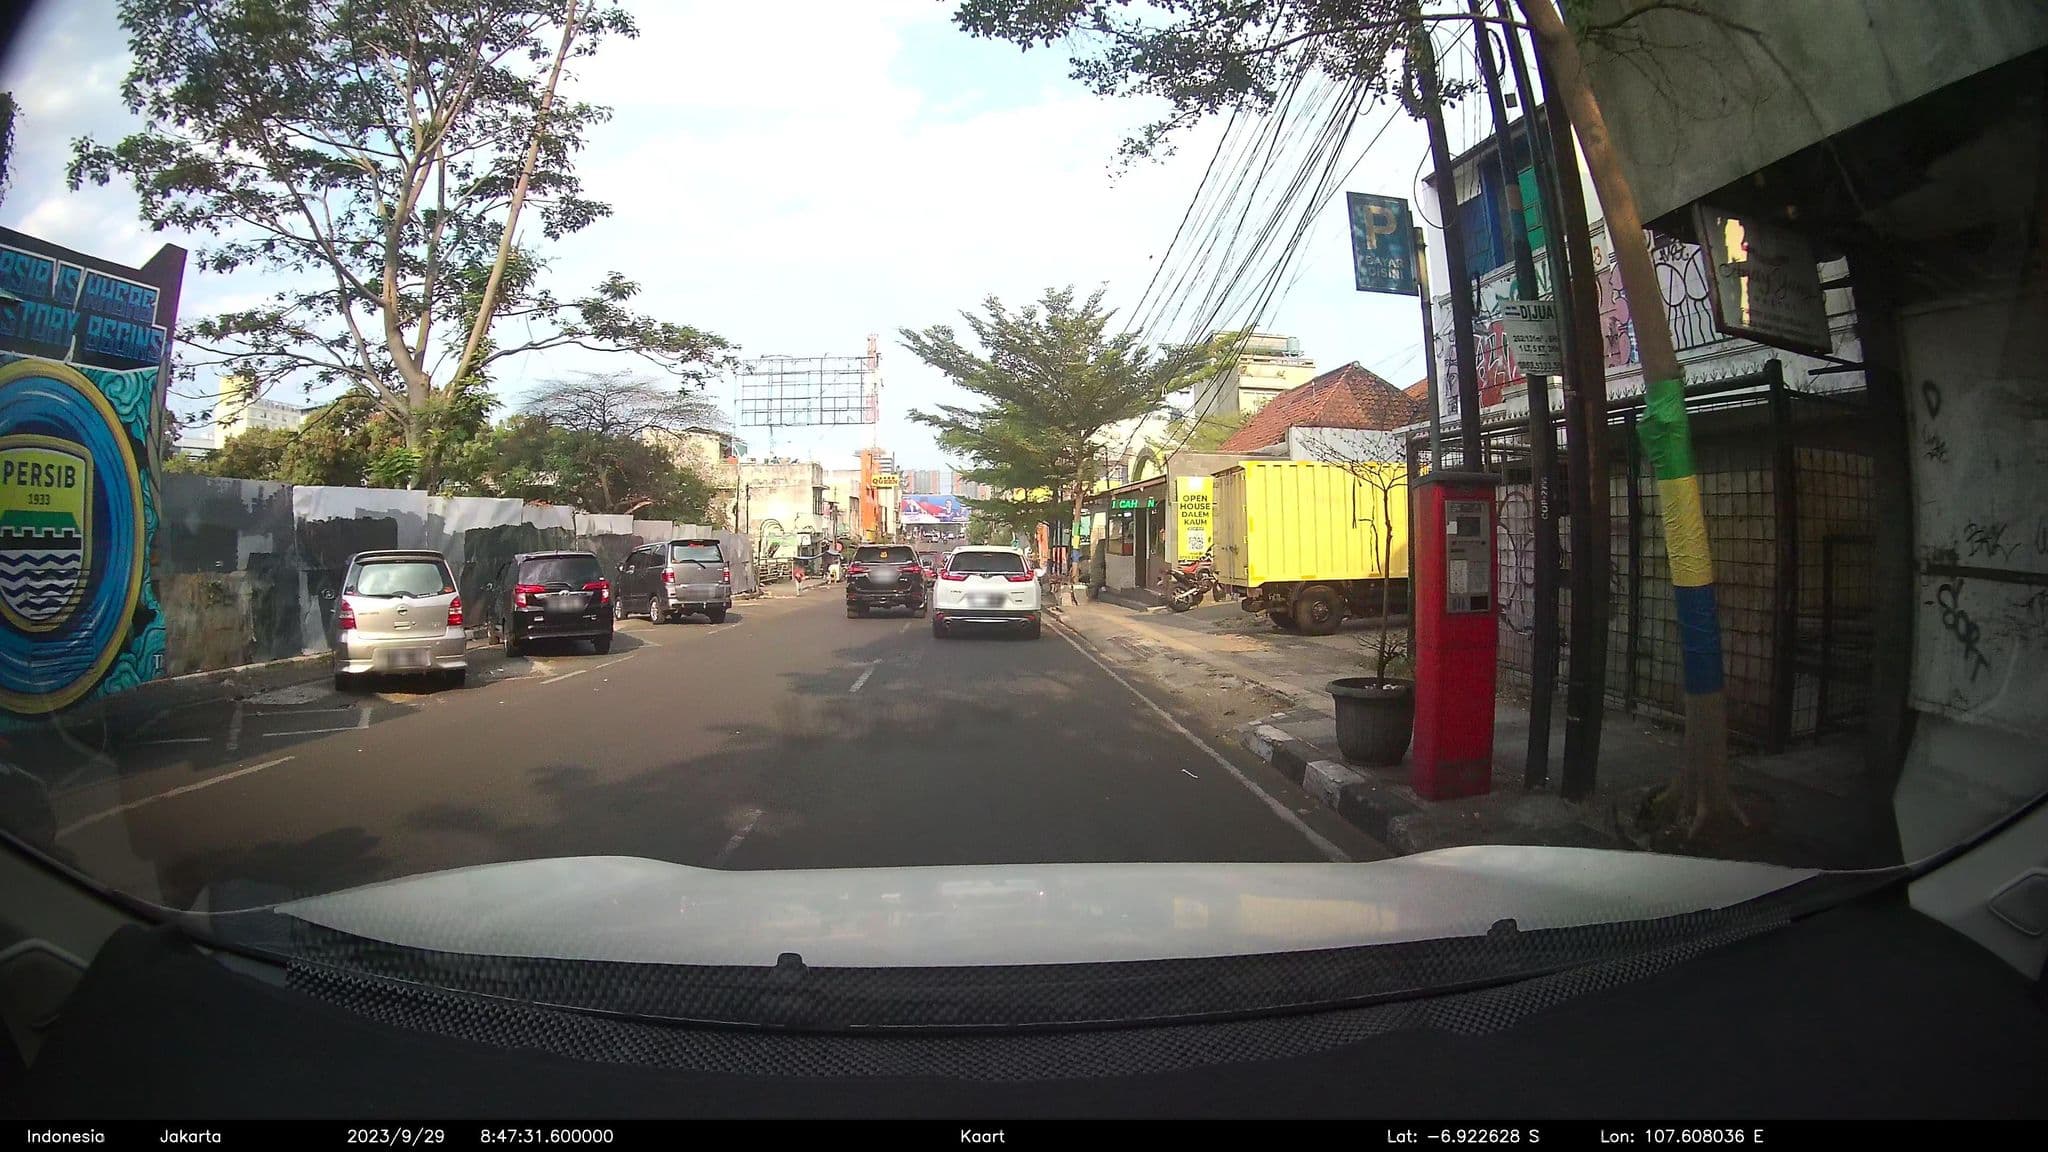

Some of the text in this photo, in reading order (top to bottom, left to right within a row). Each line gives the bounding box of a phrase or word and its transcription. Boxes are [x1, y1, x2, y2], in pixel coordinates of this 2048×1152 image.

[1365, 205, 1398, 250] P
[1519, 304, 1554, 320] DIJUA
[2, 460, 77, 489] PERSIB
[27, 493, 51, 505] 1933
